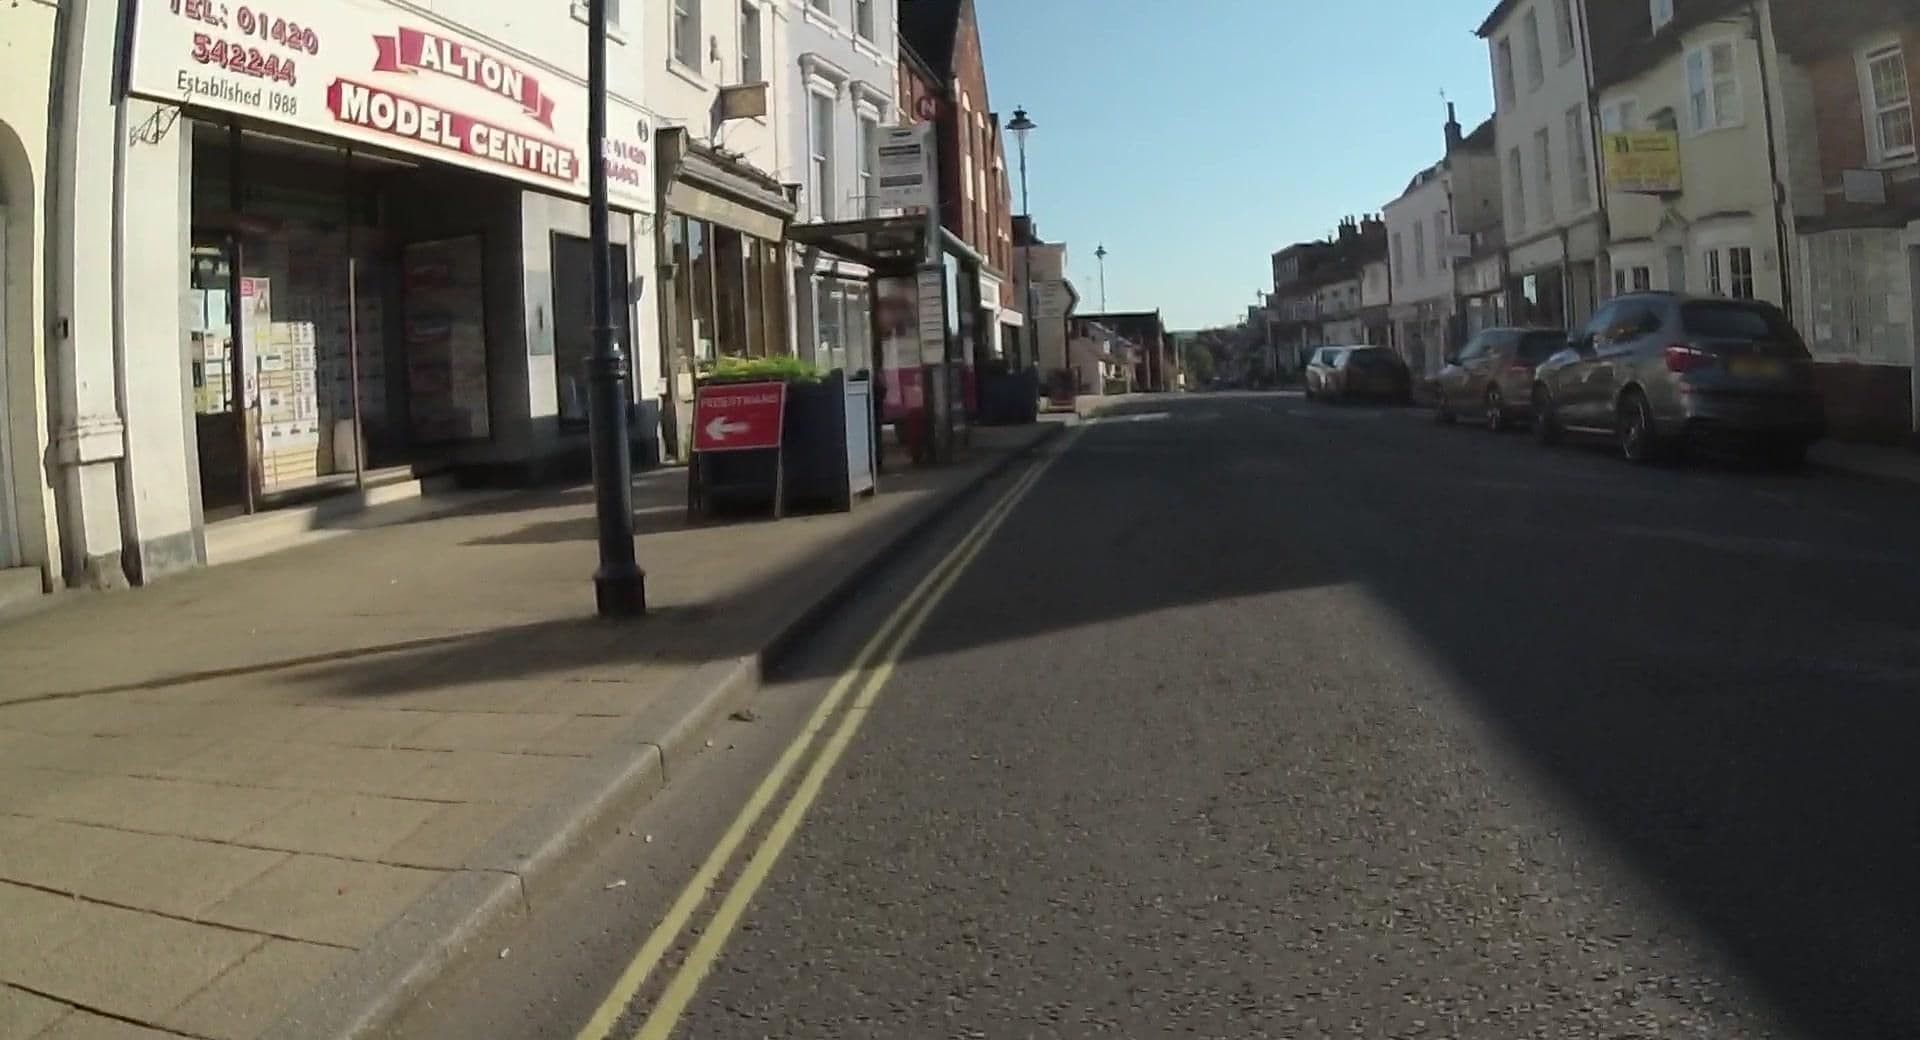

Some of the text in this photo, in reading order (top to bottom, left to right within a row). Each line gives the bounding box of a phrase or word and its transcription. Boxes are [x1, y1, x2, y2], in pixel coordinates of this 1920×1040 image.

[237, 6, 319, 55] 01420
[191, 32, 296, 87] 542244
[419, 35, 524, 101] ALTON
[177, 70, 297, 115] Established 1988
[340, 82, 461, 149] MODEL
[469, 123, 574, 178] CENTRE
